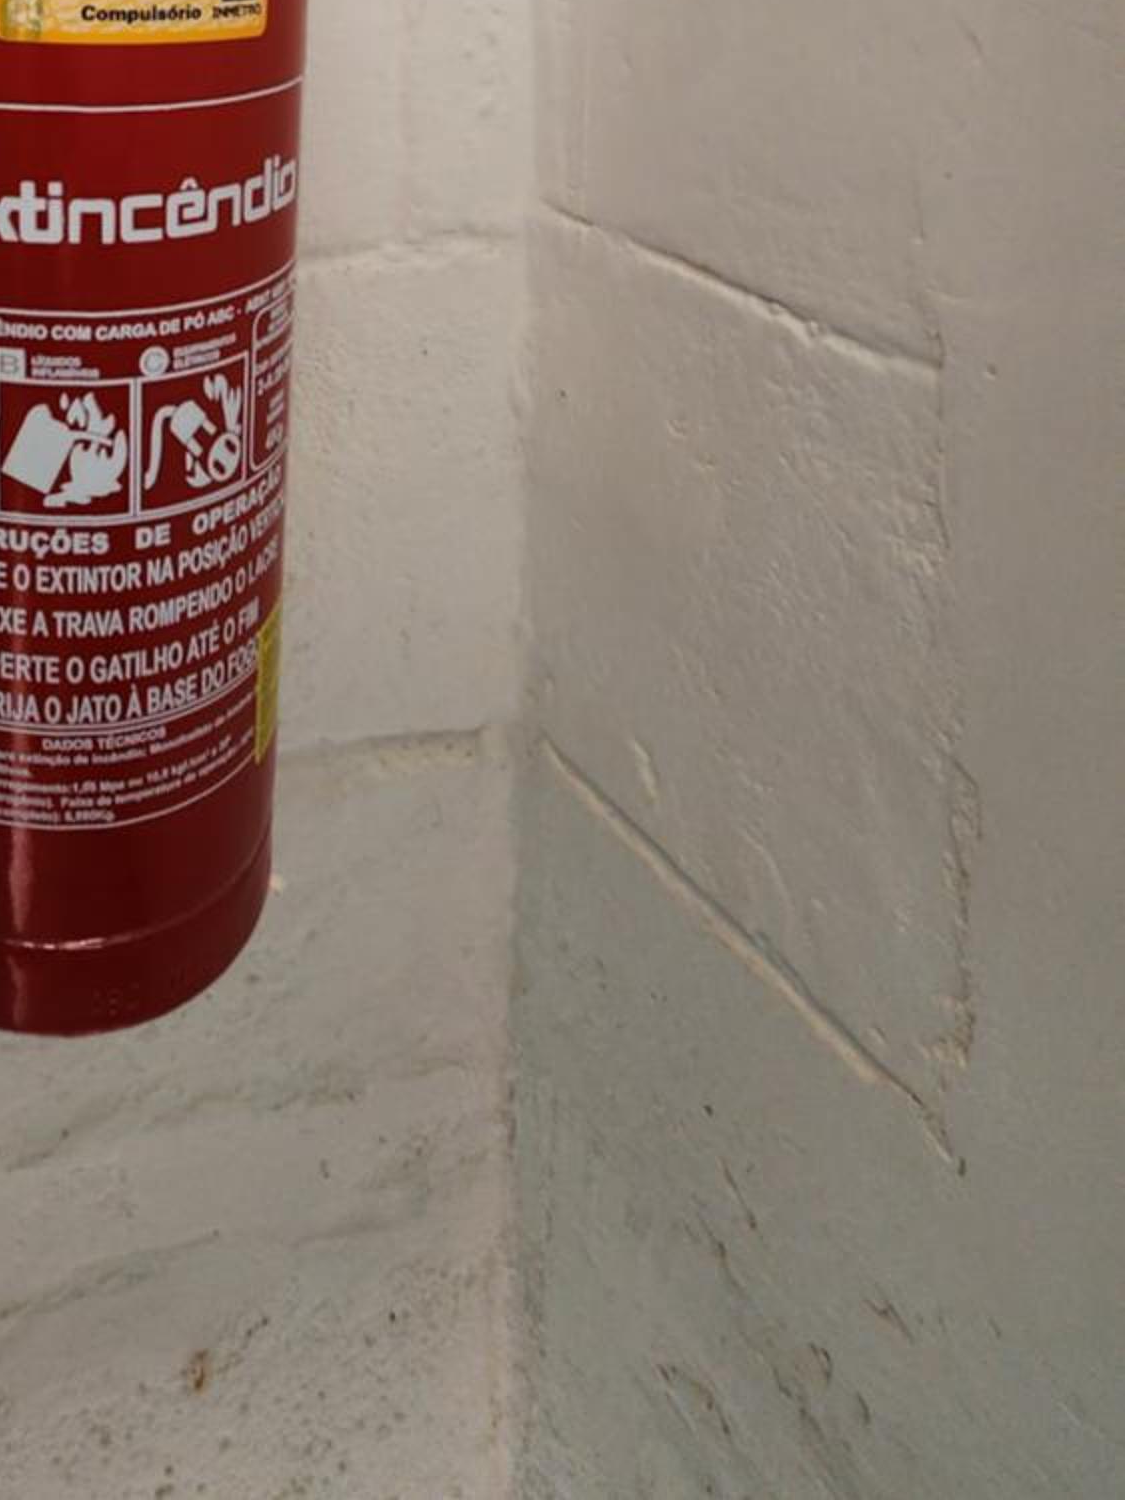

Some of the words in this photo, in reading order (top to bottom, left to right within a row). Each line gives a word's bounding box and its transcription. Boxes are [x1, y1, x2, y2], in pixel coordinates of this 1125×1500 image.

[81, 5, 202, 23] Compulsório
[51, 326, 92, 342] COM
[95, 322, 157, 342] CARGA
[159, 318, 181, 336] DE
[184, 310, 206, 332] PÓ
[13, 565, 30, 592] O
[36, 561, 142, 594] EXTINTOR
[146, 556, 174, 587] NA
[178, 525, 247, 579] POSIÇÃO
[135, 523, 171, 549] DE
[32, 611, 48, 637] A
[53, 609, 123, 637] TRAVA
[129, 579, 232, 633] ROMPENDO
[235, 566, 247, 593] O
[66, 656, 84, 684] O
[90, 641, 183, 683] GATILHO
[186, 619, 220, 664] ATÉ
[223, 616, 236, 644] O
[44, 695, 61, 723] O
[67, 694, 122, 725] JATO
[126, 683, 142, 718] À
[147, 673, 198, 715] BASE
[202, 660, 224, 695] DO
